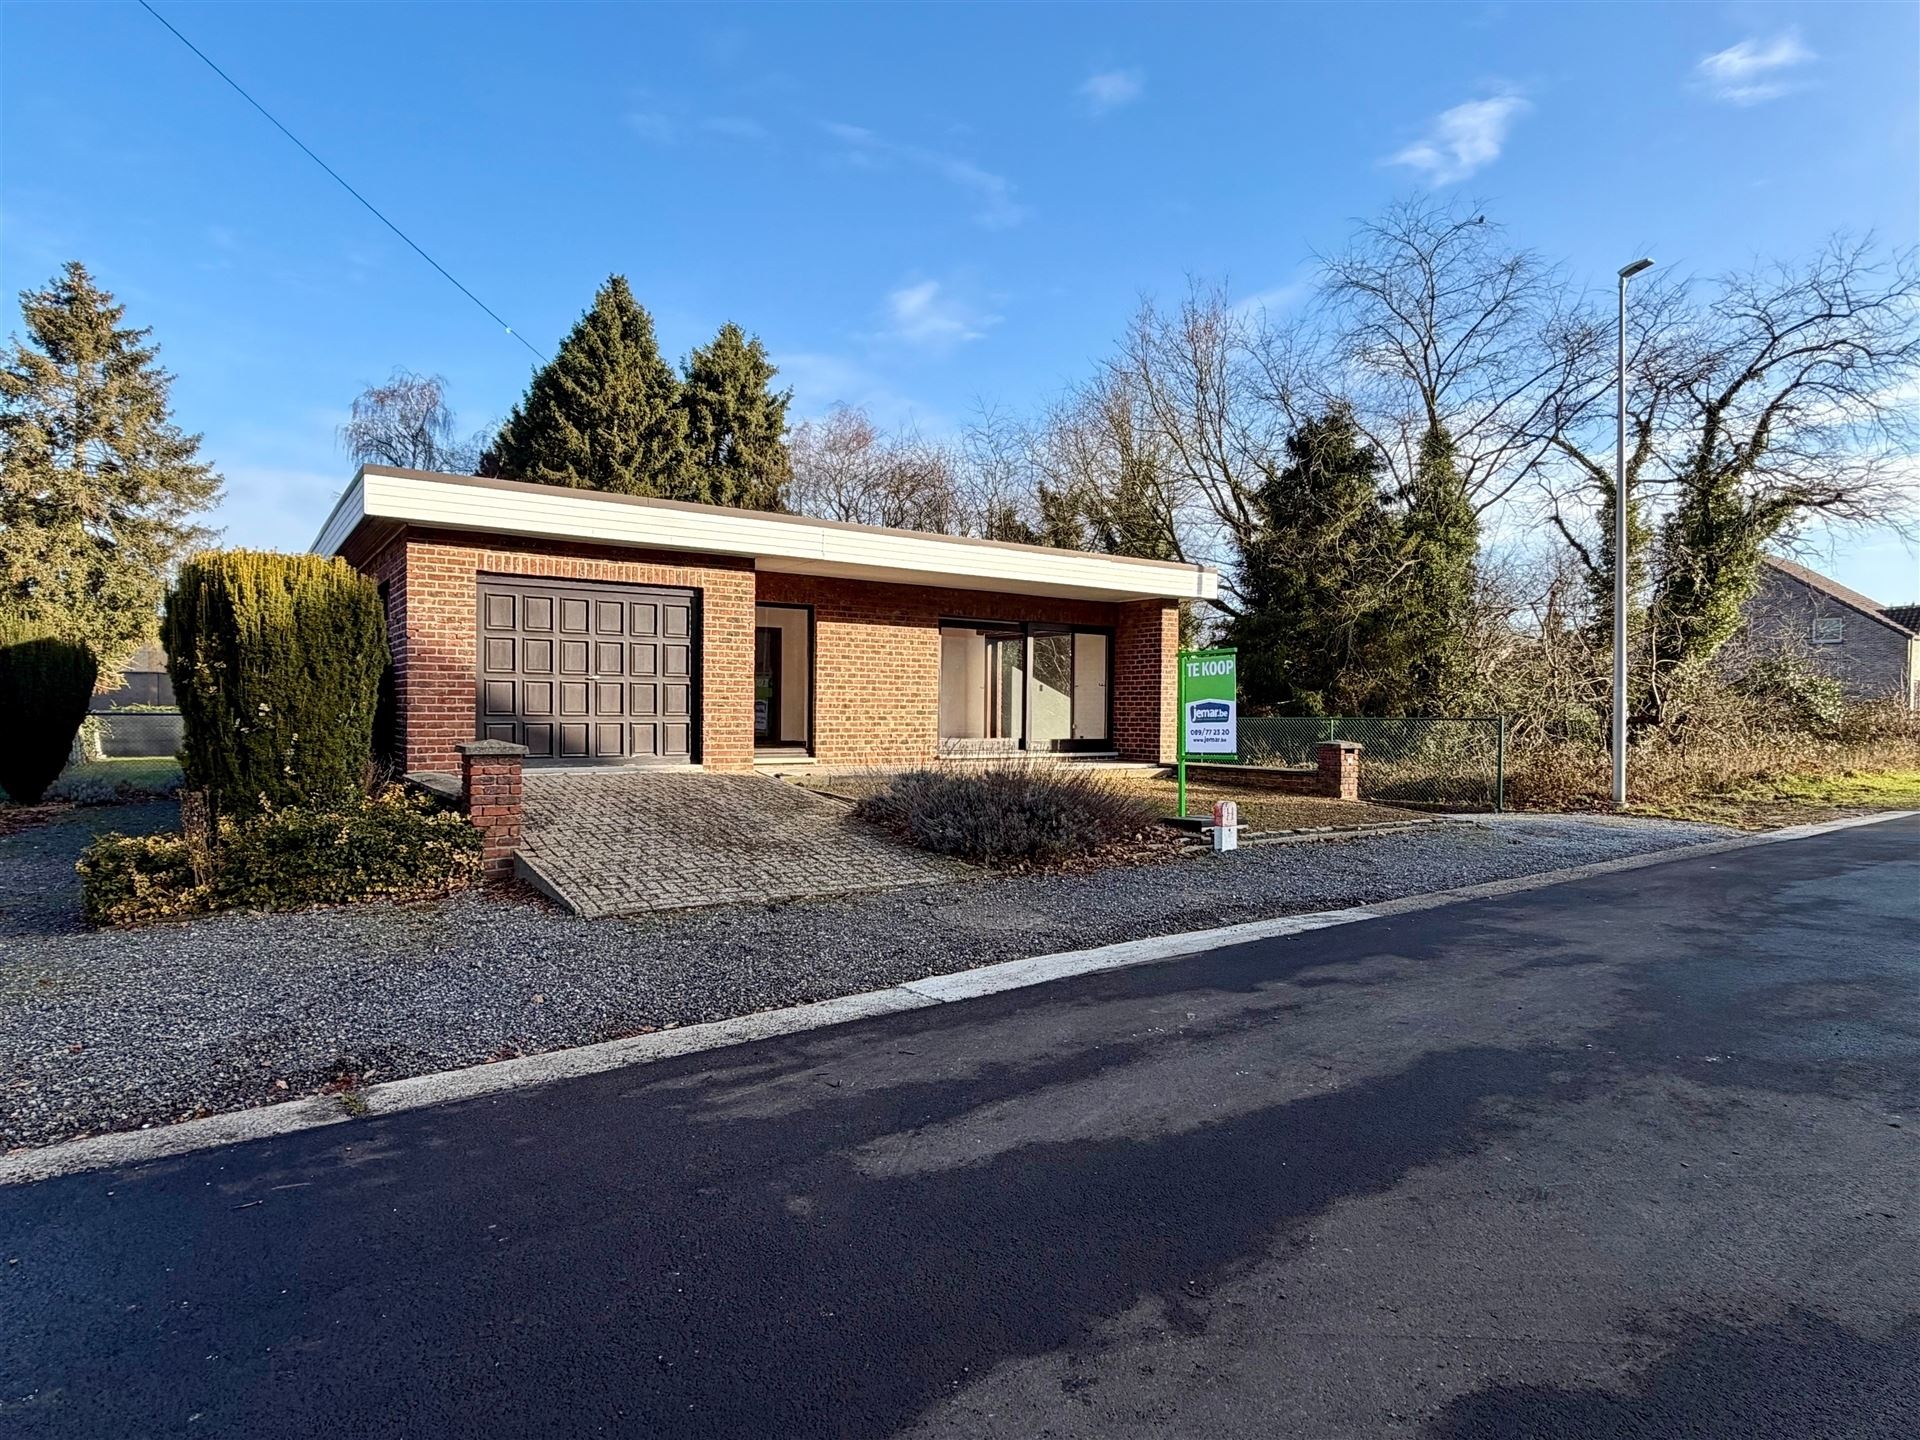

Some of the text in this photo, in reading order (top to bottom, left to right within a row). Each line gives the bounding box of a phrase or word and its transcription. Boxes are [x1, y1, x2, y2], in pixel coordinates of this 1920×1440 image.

[1186, 660, 1234, 677] TE KOOP
[1192, 704, 1229, 722] jemar.be
[1190, 727, 1212, 736] 089/77
[1222, 728, 1230, 736] 20
